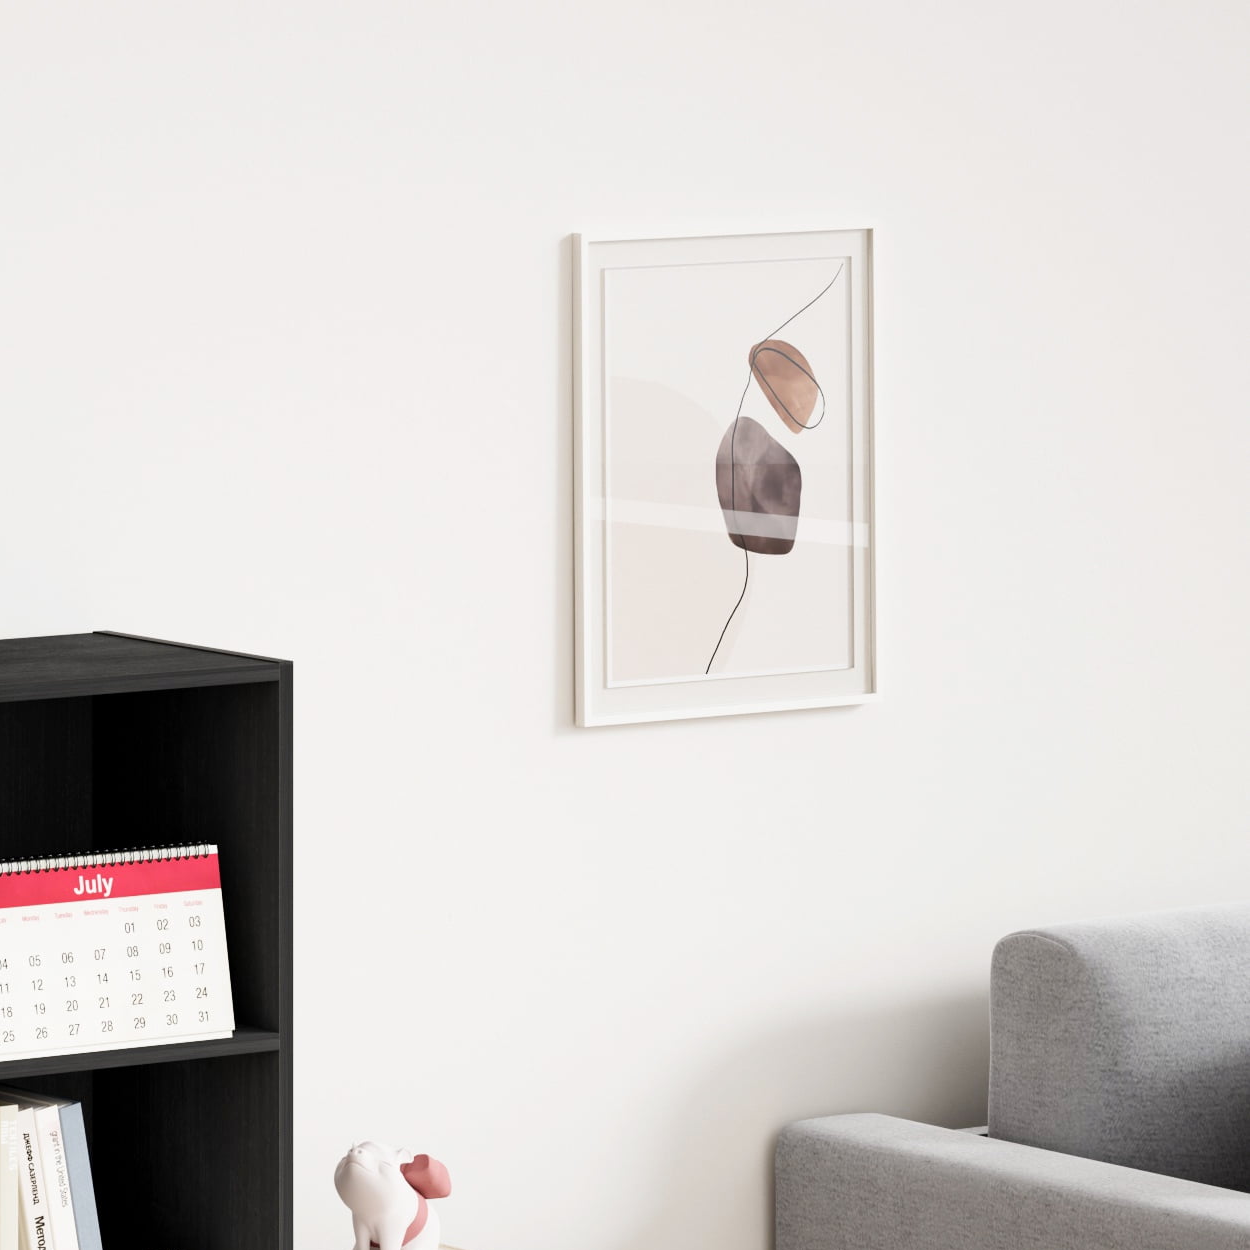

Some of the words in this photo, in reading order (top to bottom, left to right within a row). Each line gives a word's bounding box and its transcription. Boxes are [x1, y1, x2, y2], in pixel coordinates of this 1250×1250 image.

[73, 874, 114, 897] July
[124, 922, 135, 934] 01
[156, 919, 169, 931] 02
[189, 915, 201, 928] 03
[28, 955, 41, 967] 05
[61, 952, 74, 965] 06
[94, 949, 106, 962] 07
[126, 945, 139, 958] 08
[159, 942, 171, 955] 09
[192, 939, 203, 951] 10
[0, 982, 10, 994] 11
[31, 979, 43, 992] 12
[64, 976, 76, 988] 13
[97, 972, 108, 985] 14
[129, 970, 141, 982] 15
[162, 966, 174, 979] 16
[194, 963, 205, 975] 17
[1, 1006, 13, 1019] 18
[34, 1003, 46, 1015] 19
[66, 1000, 79, 1012] 20
[99, 997, 110, 1009] 21
[131, 993, 144, 1006] 22
[163, 990, 176, 1002] 23
[195, 987, 208, 999] 24
[2, 1030, 15, 1043] 25
[35, 1027, 48, 1040] 26
[68, 1024, 80, 1036] 27
[101, 1020, 114, 1032] 28
[133, 1017, 146, 1030] 29
[166, 1014, 178, 1026] 30
[198, 1011, 209, 1023] 31
[22, 1133, 33, 1161] ДЖЕФФ
[27, 1162, 40, 1205] САЗЕРЛЕНД
